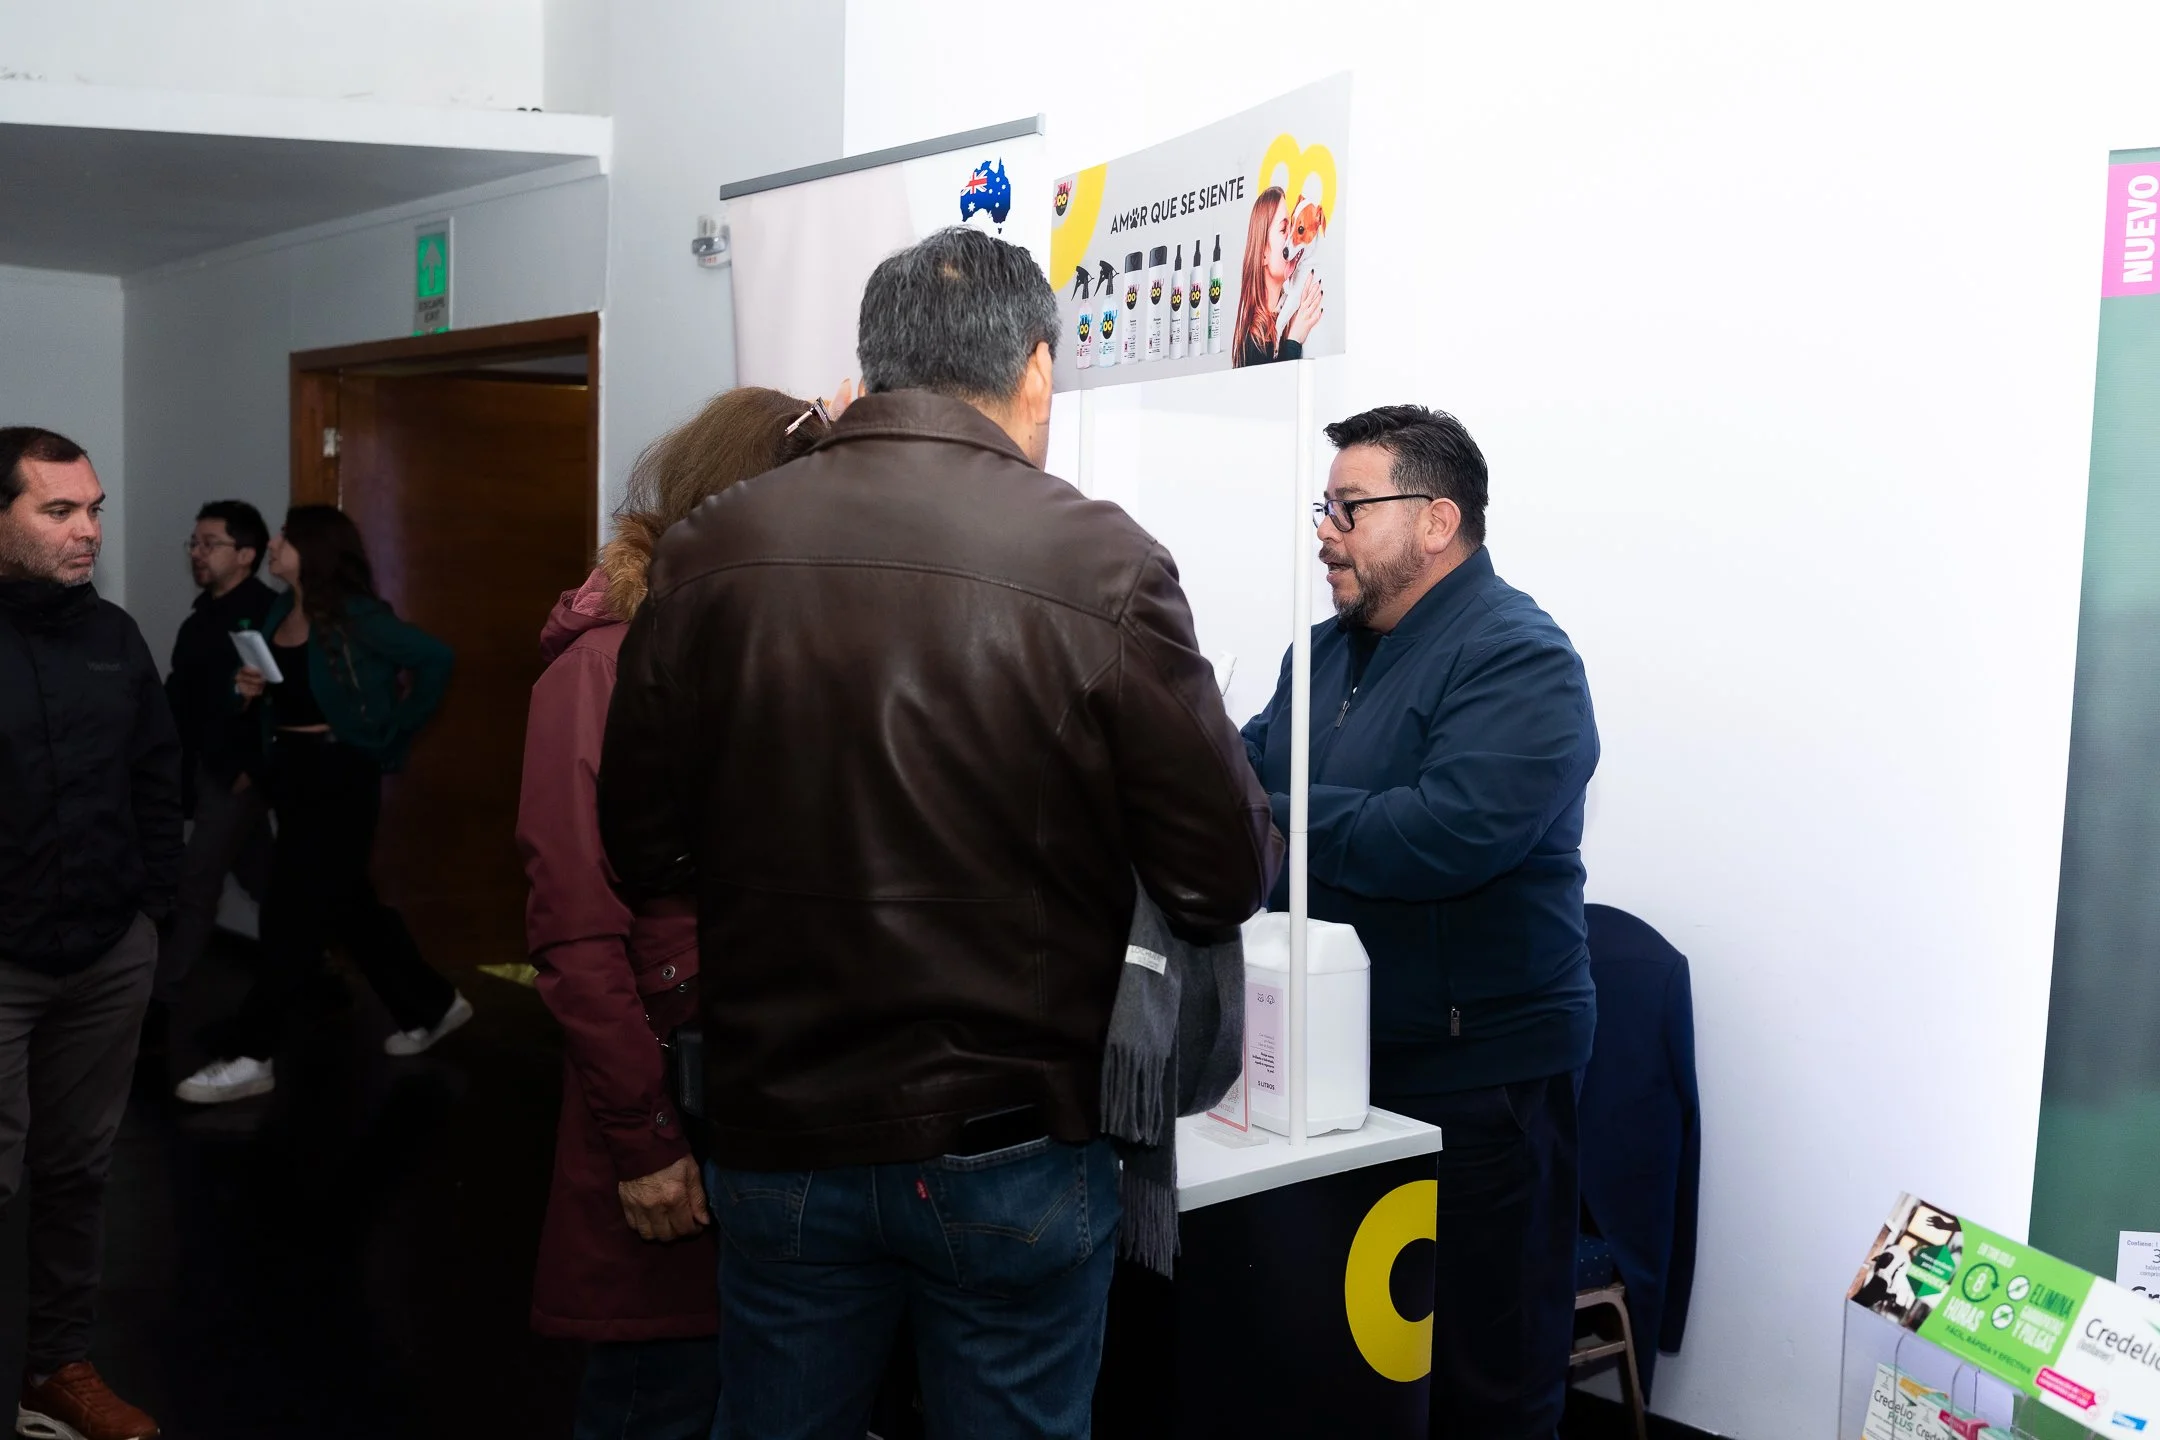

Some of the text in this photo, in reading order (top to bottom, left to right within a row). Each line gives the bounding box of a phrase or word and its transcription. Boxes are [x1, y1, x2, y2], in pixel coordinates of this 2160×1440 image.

[1151, 196, 1178, 224] QUE
[1180, 191, 1196, 215] SE
[1198, 176, 1245, 210] SIENTE
[2122, 174, 2159, 283] NUEVO
[1261, 1081, 1275, 1090] LITROS
[1874, 1389, 1913, 1420] Credelio
